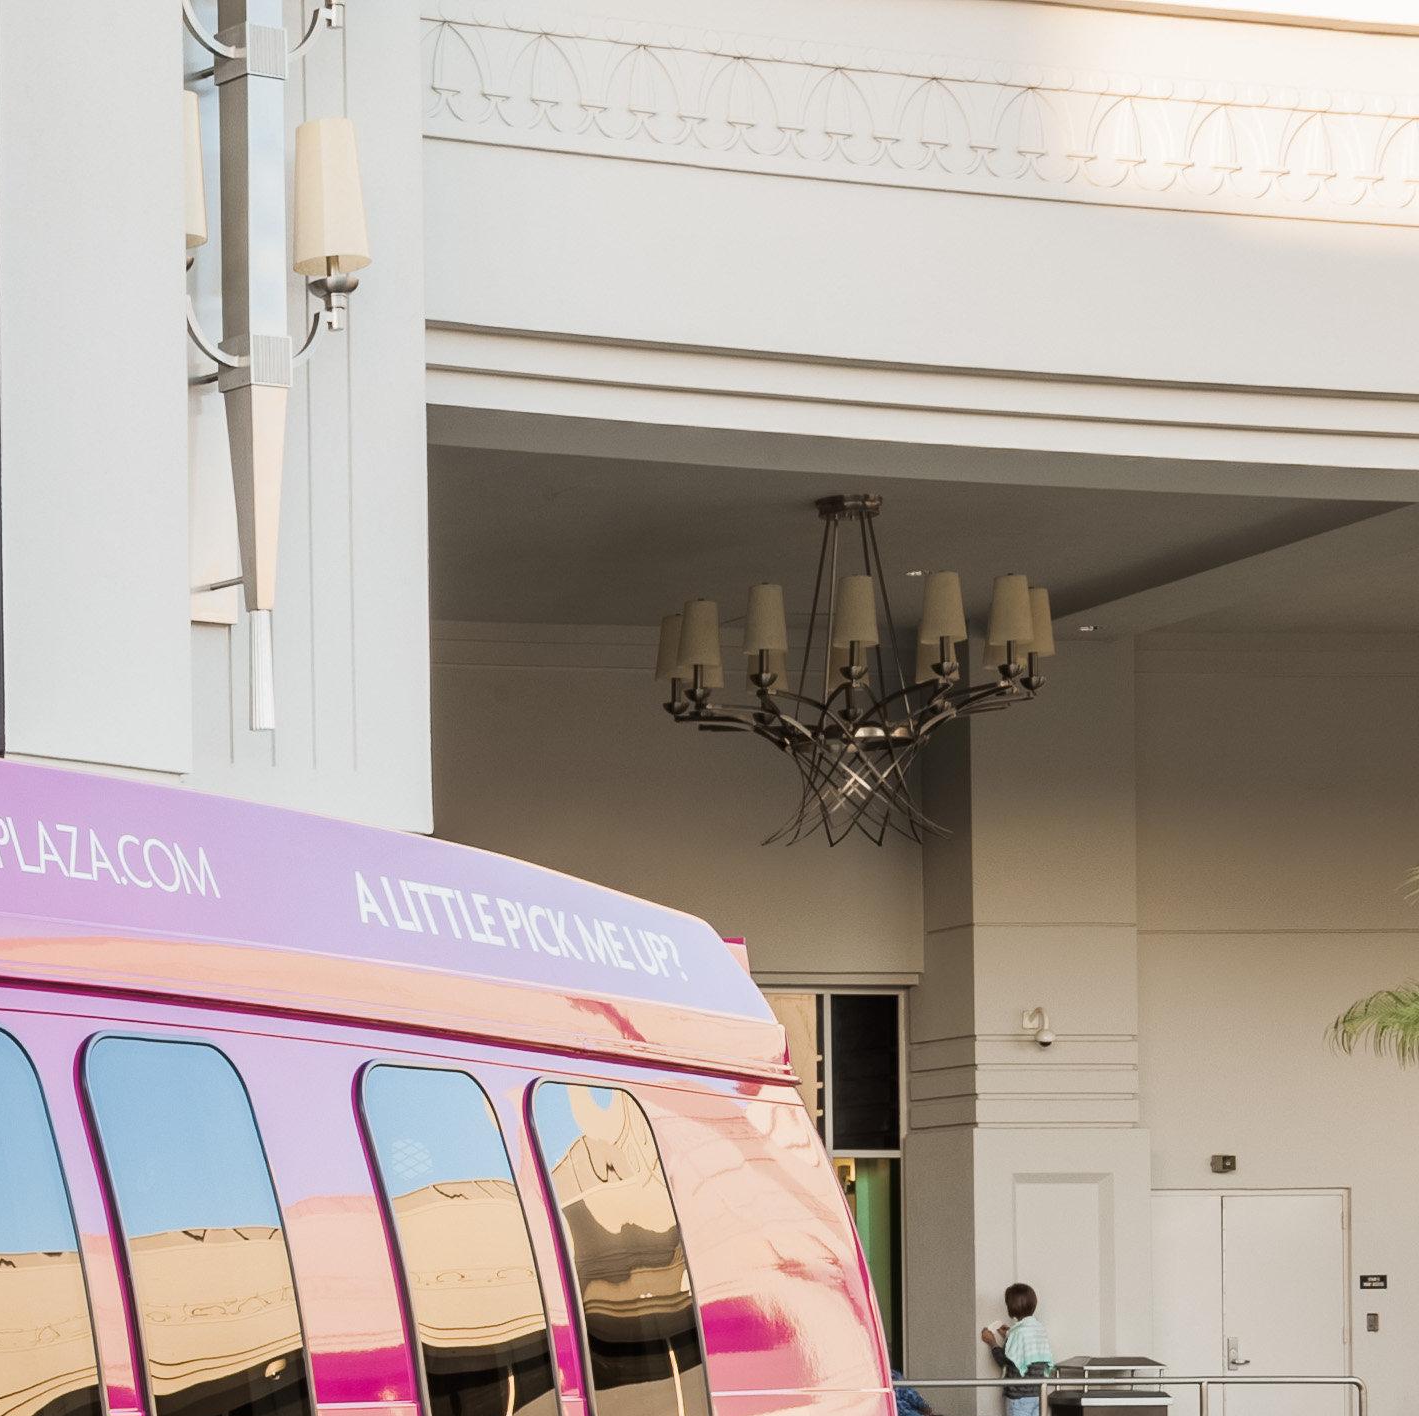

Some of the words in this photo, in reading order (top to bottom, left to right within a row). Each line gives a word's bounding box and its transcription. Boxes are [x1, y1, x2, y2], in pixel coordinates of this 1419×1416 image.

[354, 870, 390, 928] A
[379, 875, 507, 947] LITTLE
[495, 897, 583, 961] PICK
[572, 913, 637, 971] ME
[624, 926, 689, 982] UP?
